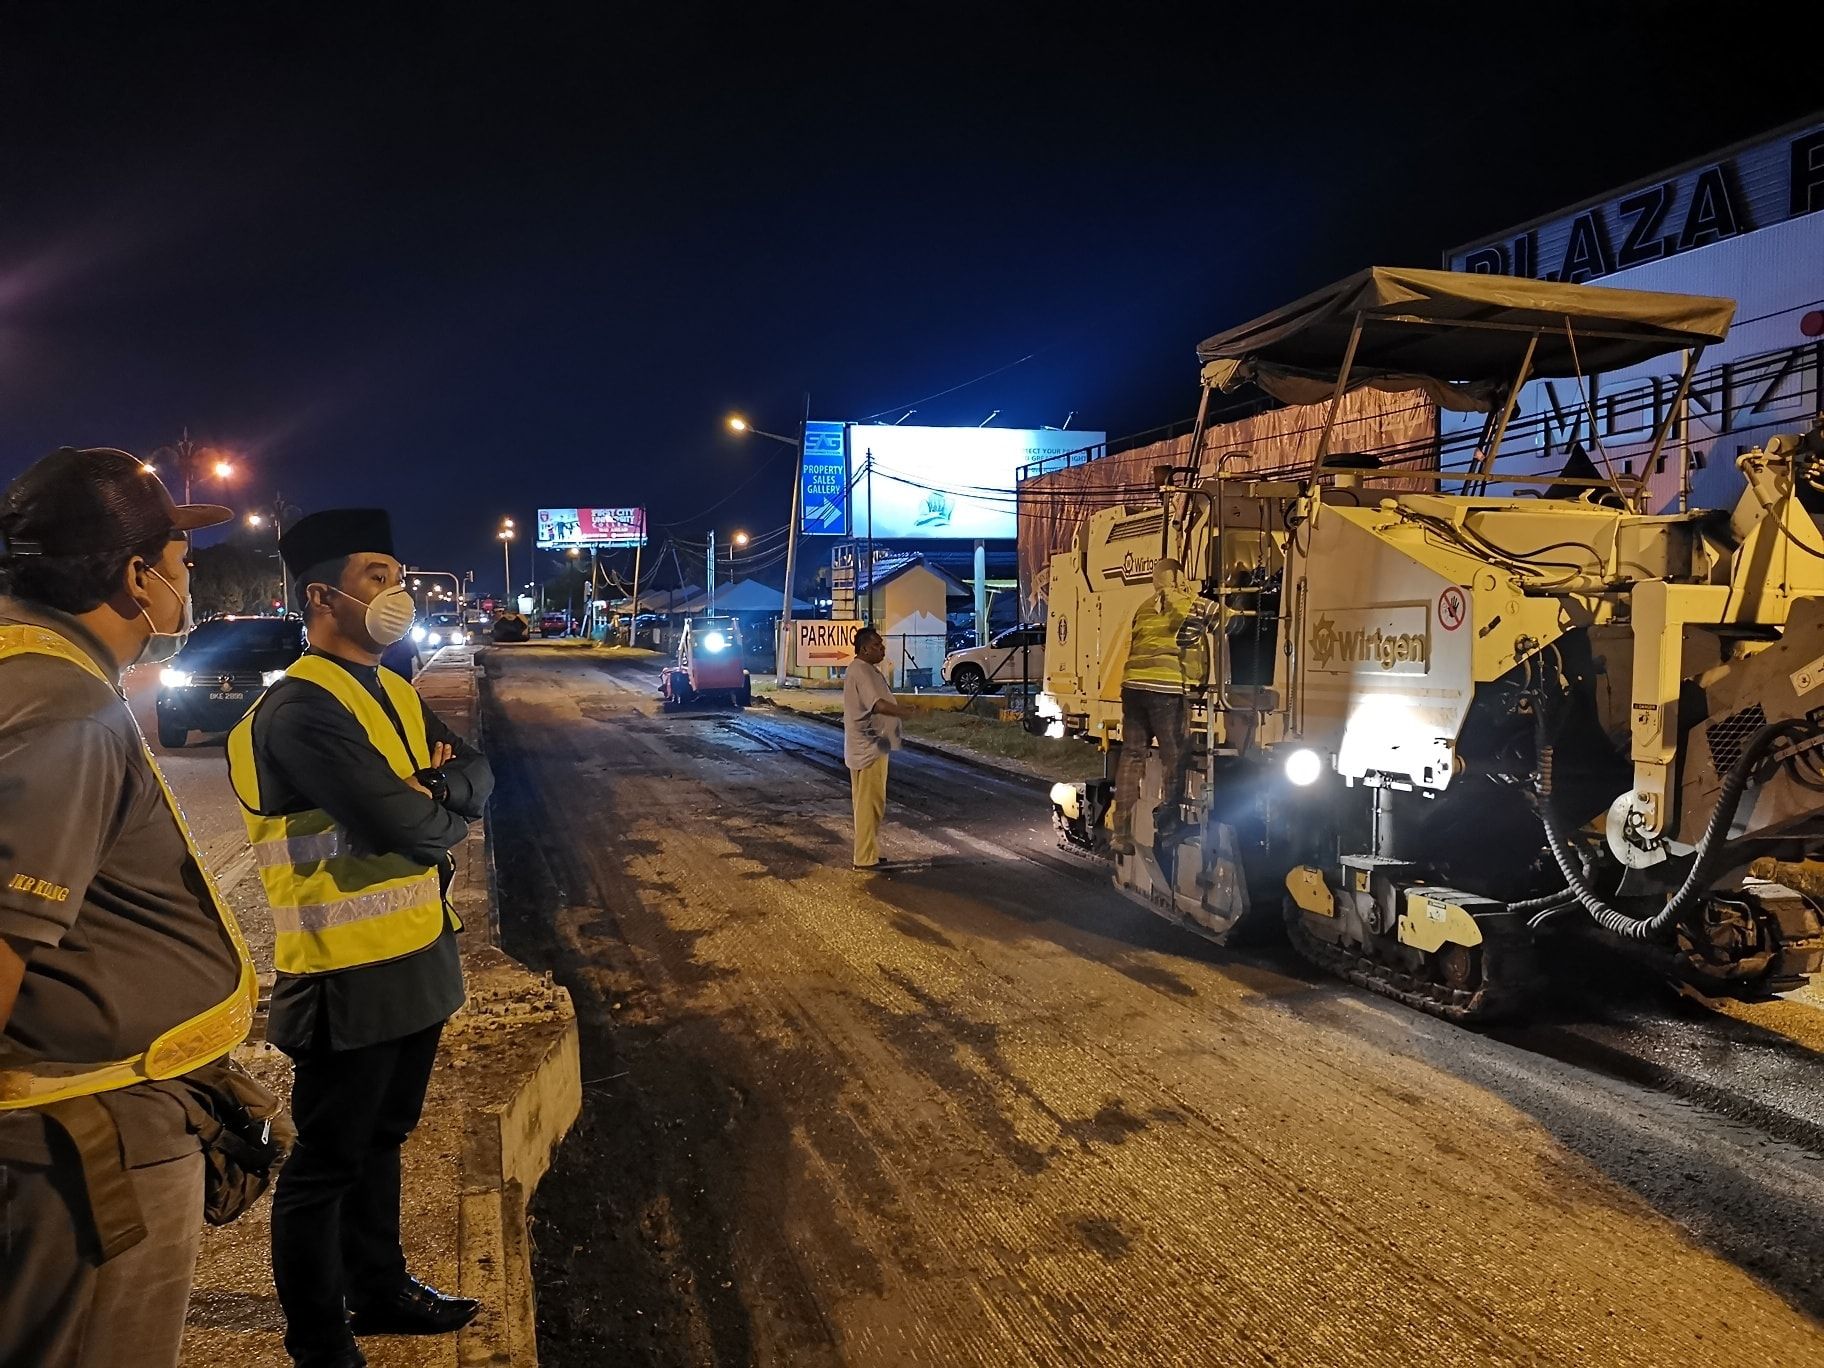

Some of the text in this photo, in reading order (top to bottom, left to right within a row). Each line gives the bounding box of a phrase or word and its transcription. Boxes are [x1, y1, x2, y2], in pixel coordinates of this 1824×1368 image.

[803, 464, 844, 475] PROPERTY
[812, 475, 836, 485] SALES
[807, 484, 841, 495] GALLERY
[1133, 556, 1158, 574] Wirtge
[1338, 625, 1426, 670] Wirtgen
